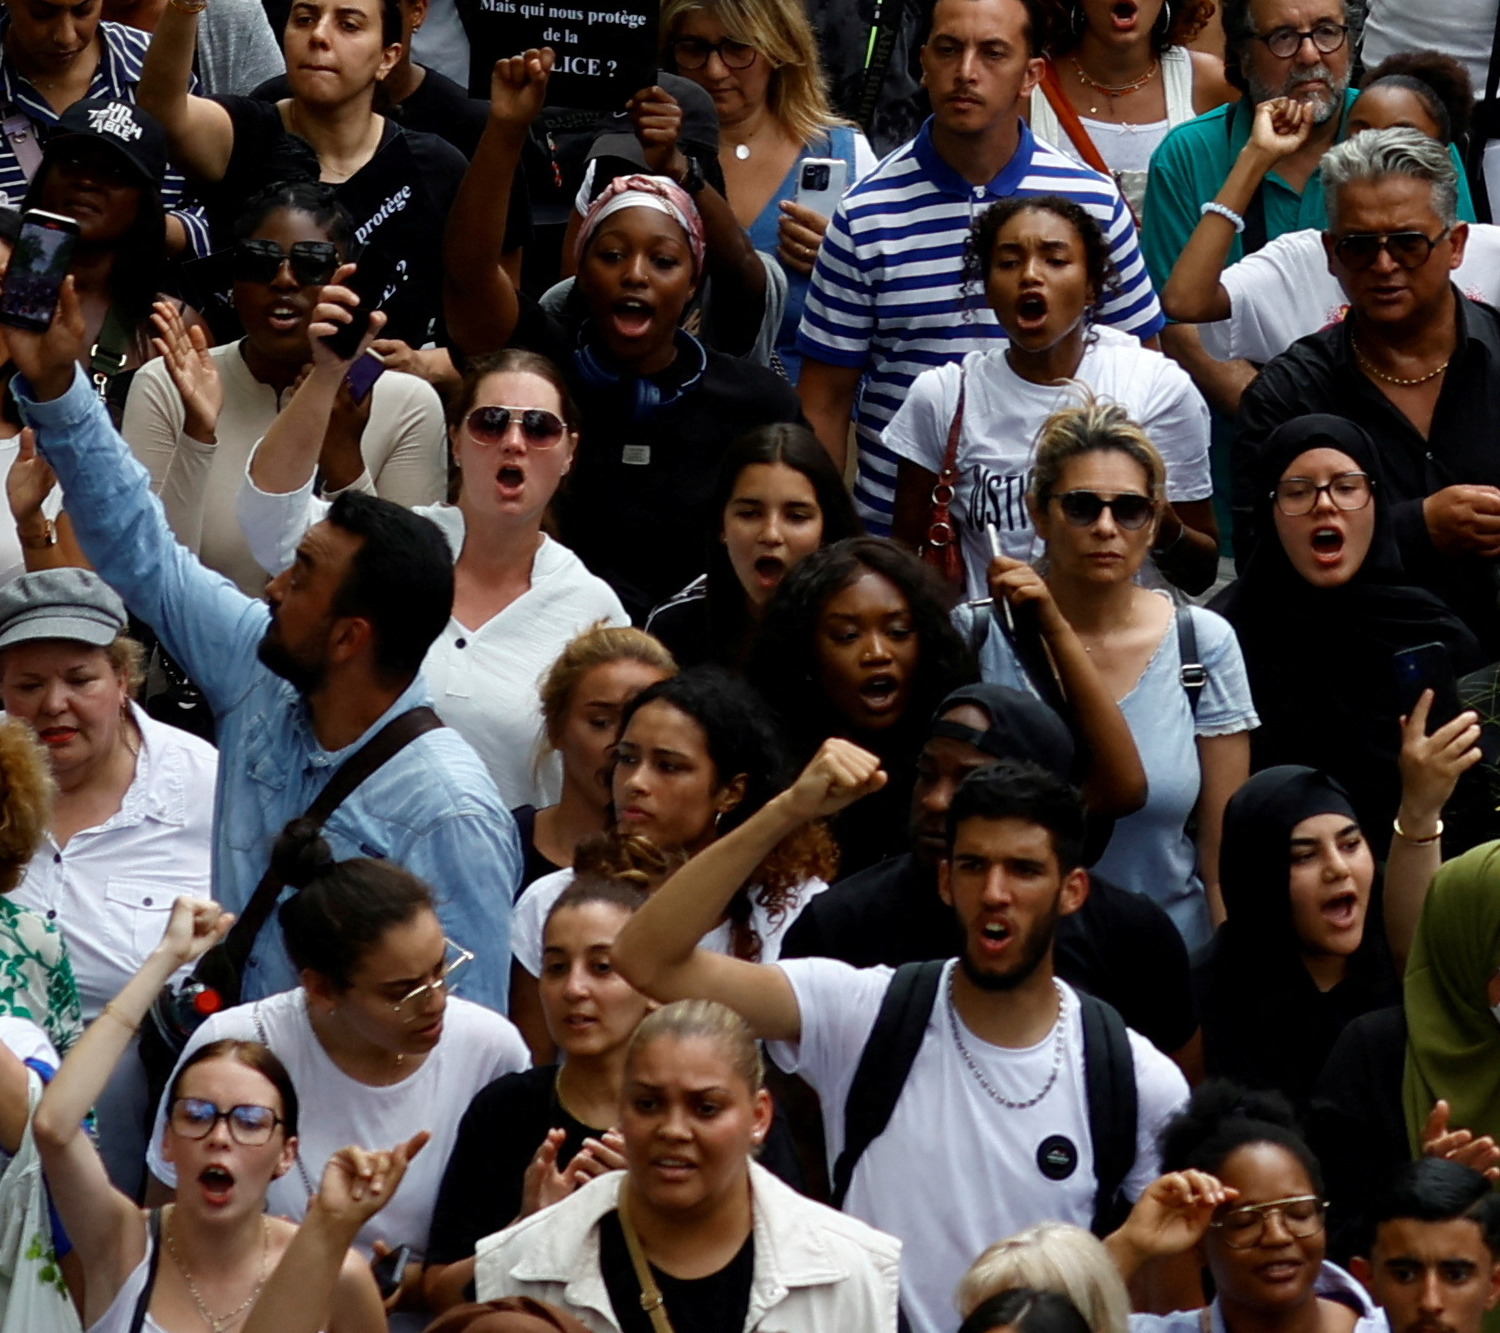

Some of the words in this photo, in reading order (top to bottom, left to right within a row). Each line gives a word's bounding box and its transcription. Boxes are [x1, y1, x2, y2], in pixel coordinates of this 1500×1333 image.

[547, 4, 585, 21] nous
[586, 6, 646, 28] protège
[542, 26, 561, 43] de
[562, 28, 579, 45] la
[548, 48, 601, 78] LICE
[605, 59, 618, 80] ?
[353, 183, 413, 248] protège
